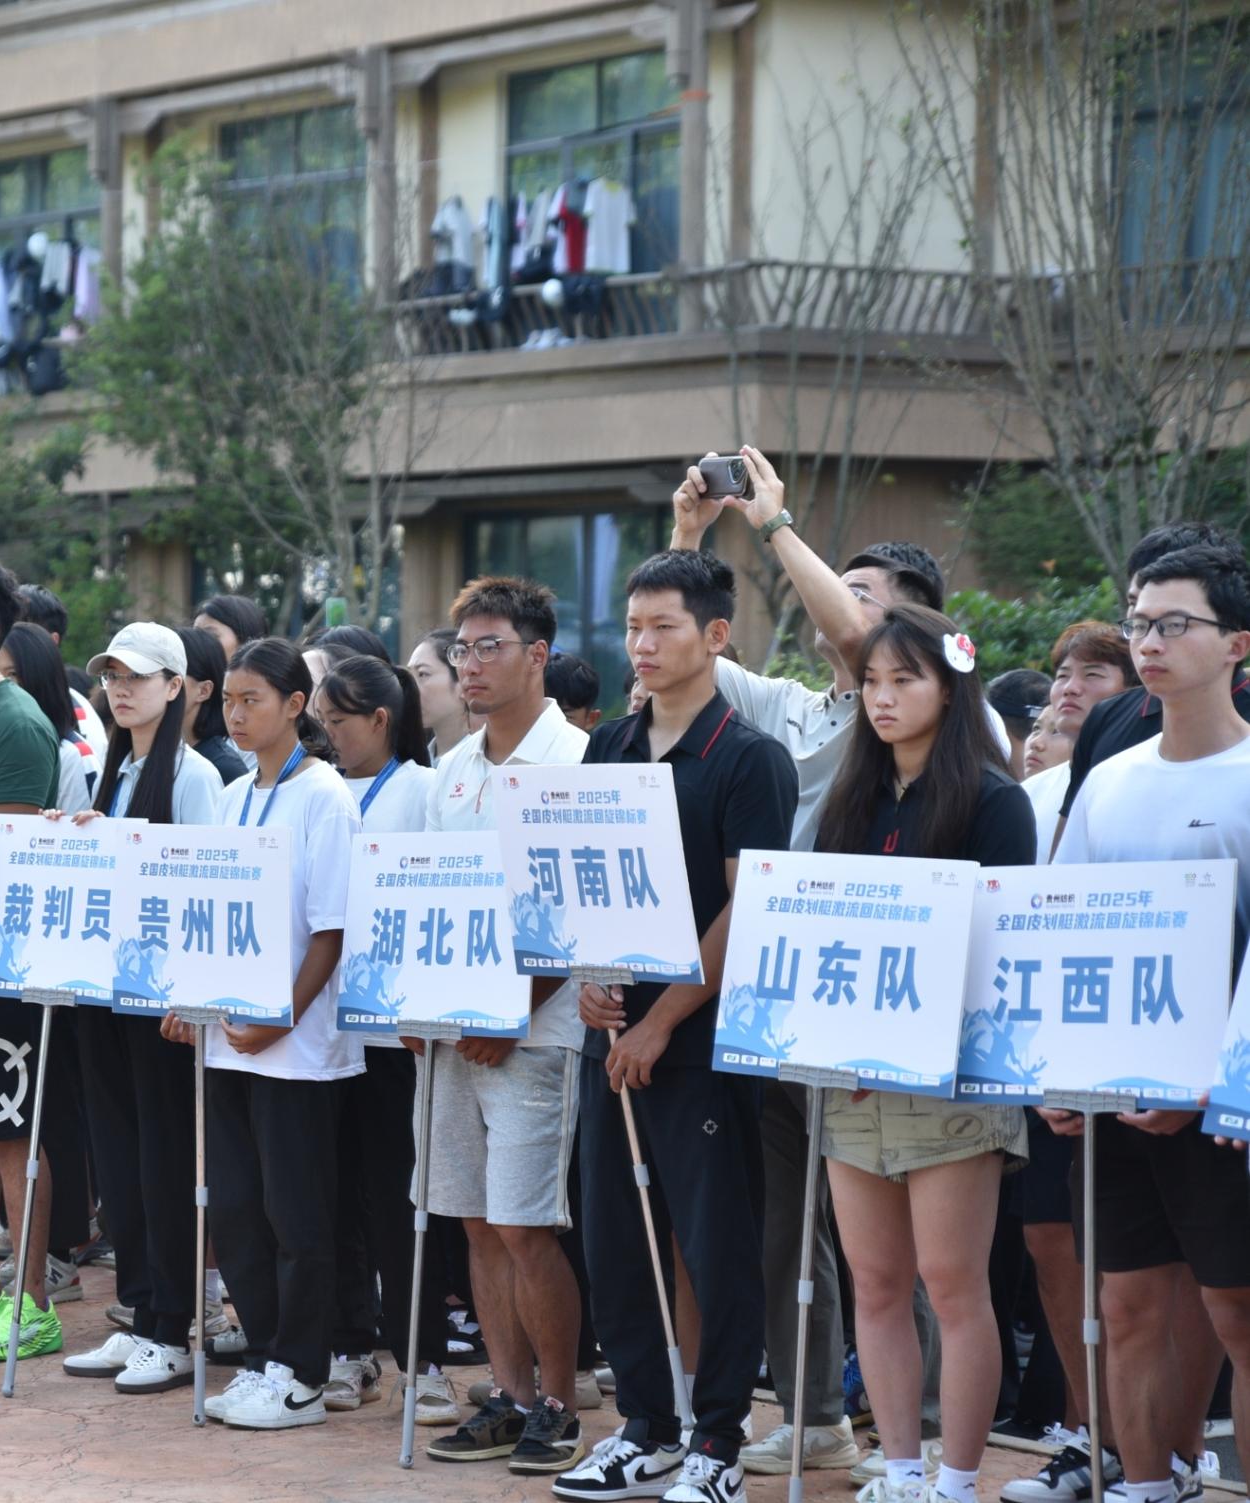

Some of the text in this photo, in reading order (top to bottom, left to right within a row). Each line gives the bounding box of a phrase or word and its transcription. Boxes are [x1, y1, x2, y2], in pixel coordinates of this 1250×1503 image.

[578, 790, 621, 805] 2025年
[522, 808, 647, 825] 全国皮划艇激流回旋锦标赛
[61, 838, 100, 852] 2025年
[196, 849, 239, 863] 2025年
[438, 854, 484, 869] 2025年
[139, 862, 263, 881] 全国皮划艇激流回旋锦标赛
[374, 872, 505, 888] 全国皮划艇激流回旋锦标赛
[527, 845, 660, 909] 河南队
[844, 882, 903, 901] 2025年
[1086, 890, 1154, 908] 2025年
[3, 883, 111, 942] 裁判员
[765, 895, 933, 923] 全国皮划艇激流回旋锦标赛
[137, 896, 262, 958] 贵州队
[995, 911, 1189, 931] 全国皮划艇激流回旋锦标赛
[371, 908, 501, 967] 湖北队
[755, 935, 922, 1013] 山东队
[992, 954, 1184, 1025] 江西队
